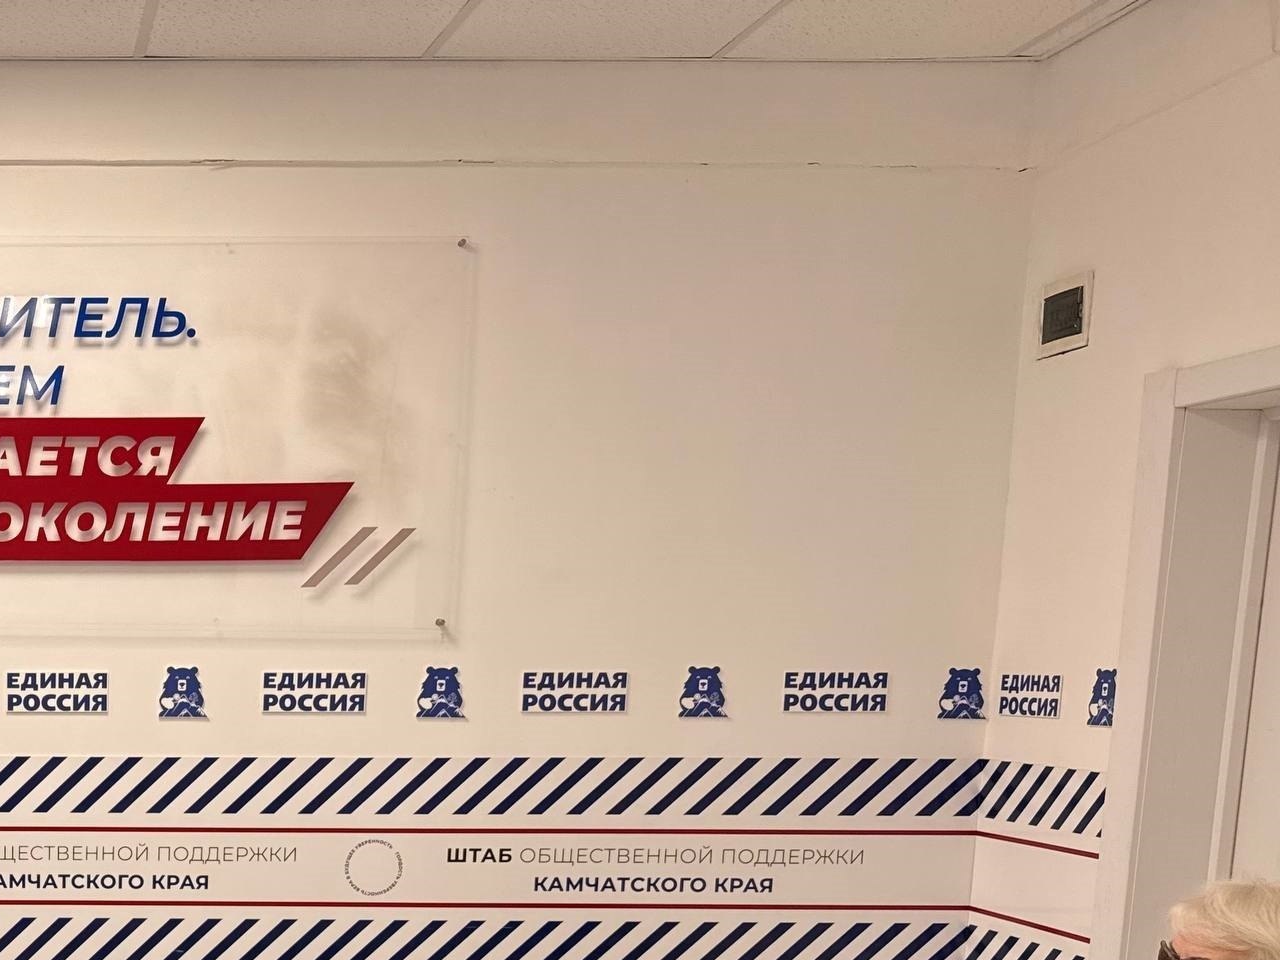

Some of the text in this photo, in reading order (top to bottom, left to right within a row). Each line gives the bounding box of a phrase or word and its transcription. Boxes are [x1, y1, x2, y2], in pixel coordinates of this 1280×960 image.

[8, 672, 107, 691] ЕДИНАЯ
[264, 672, 365, 691] ЕДИНАЯ
[523, 672, 627, 691] ЕДИНАЯ
[785, 672, 888, 691] ЕДИНАЯ
[1001, 674, 1061, 693] ЕДИНАЯ
[8, 693, 107, 711] РОССИЯ
[264, 693, 365, 711] РОССИЯ
[523, 693, 626, 711] РОССИЯ
[784, 693, 886, 711] РОССИЯ
[999, 697, 1058, 716] РОССИЯ
[157, 846, 297, 865] ПОДДЕРЖКИ
[447, 846, 864, 867] ШТАБ ОБЩЕСТВЕННОЙ ПОДДЕРЖКИ
[152, 874, 209, 890] КРАЯ
[534, 876, 773, 893] КАМЧАТСКОГО КРАЯ
